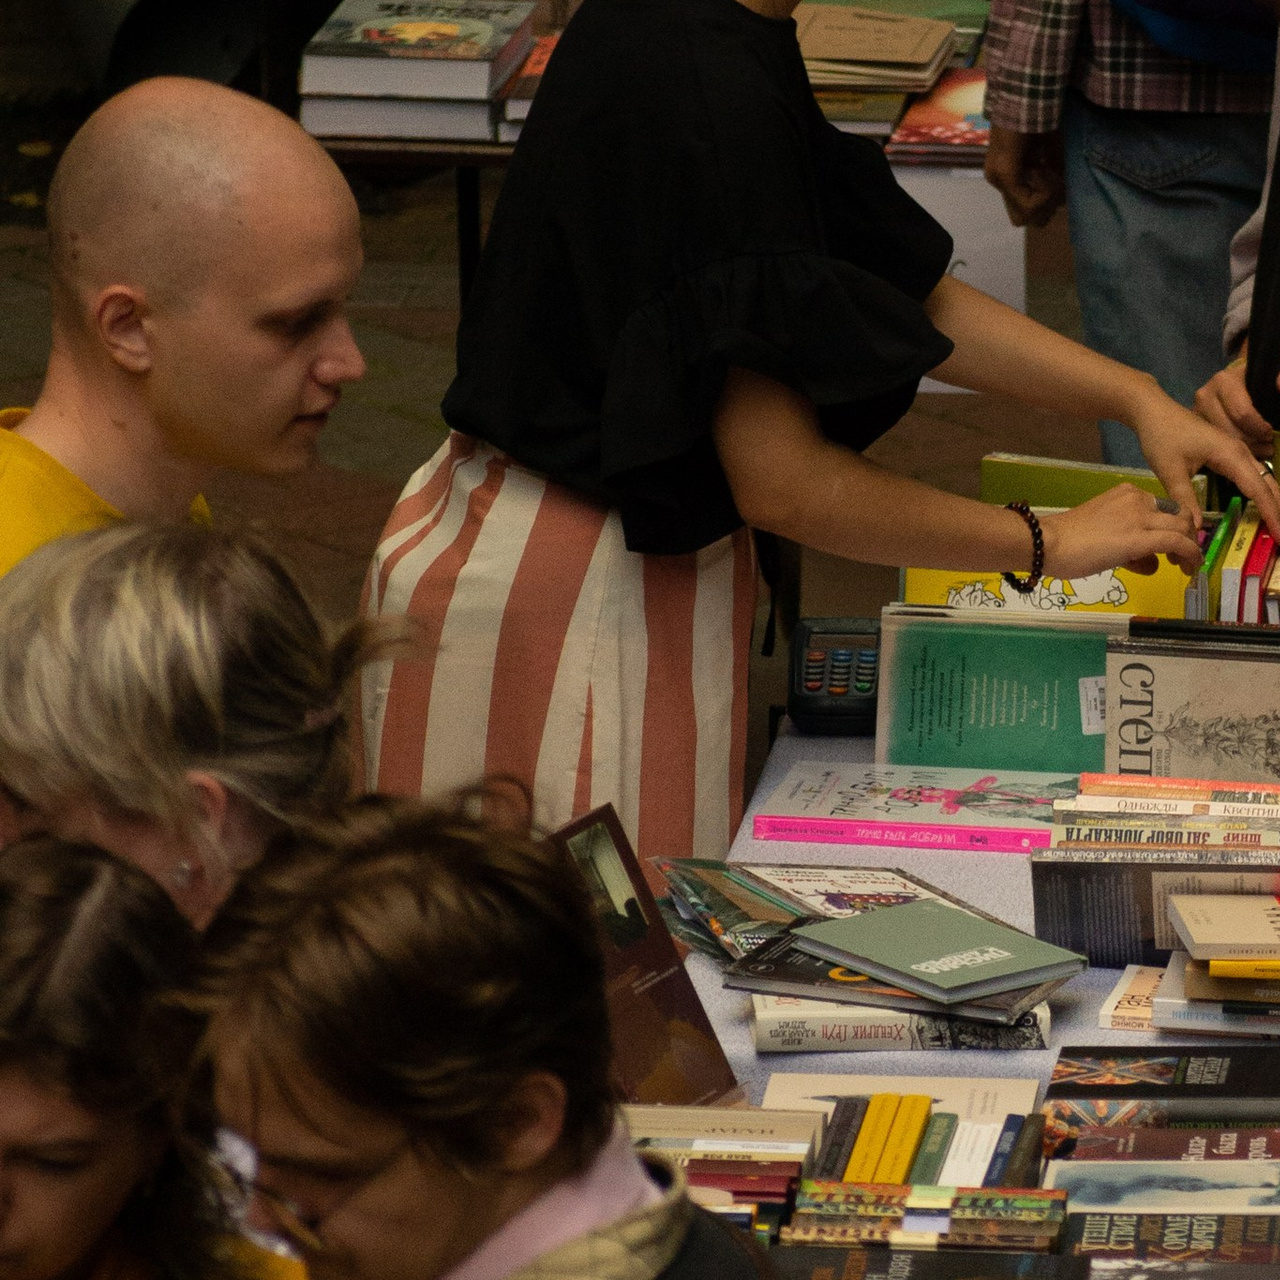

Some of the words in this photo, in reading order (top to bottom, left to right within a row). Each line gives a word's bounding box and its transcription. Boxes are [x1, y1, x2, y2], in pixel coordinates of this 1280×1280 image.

[1118, 797, 1178, 816] Однажды
[1222, 803, 1280, 819] Квентин
[886, 827, 908, 842] БЫТЬ
[910, 829, 957, 846] ДОБРЫМ
[1064, 825, 1144, 845] ЛОККАРТА
[1145, 827, 1211, 846] ЗАГОВОР
